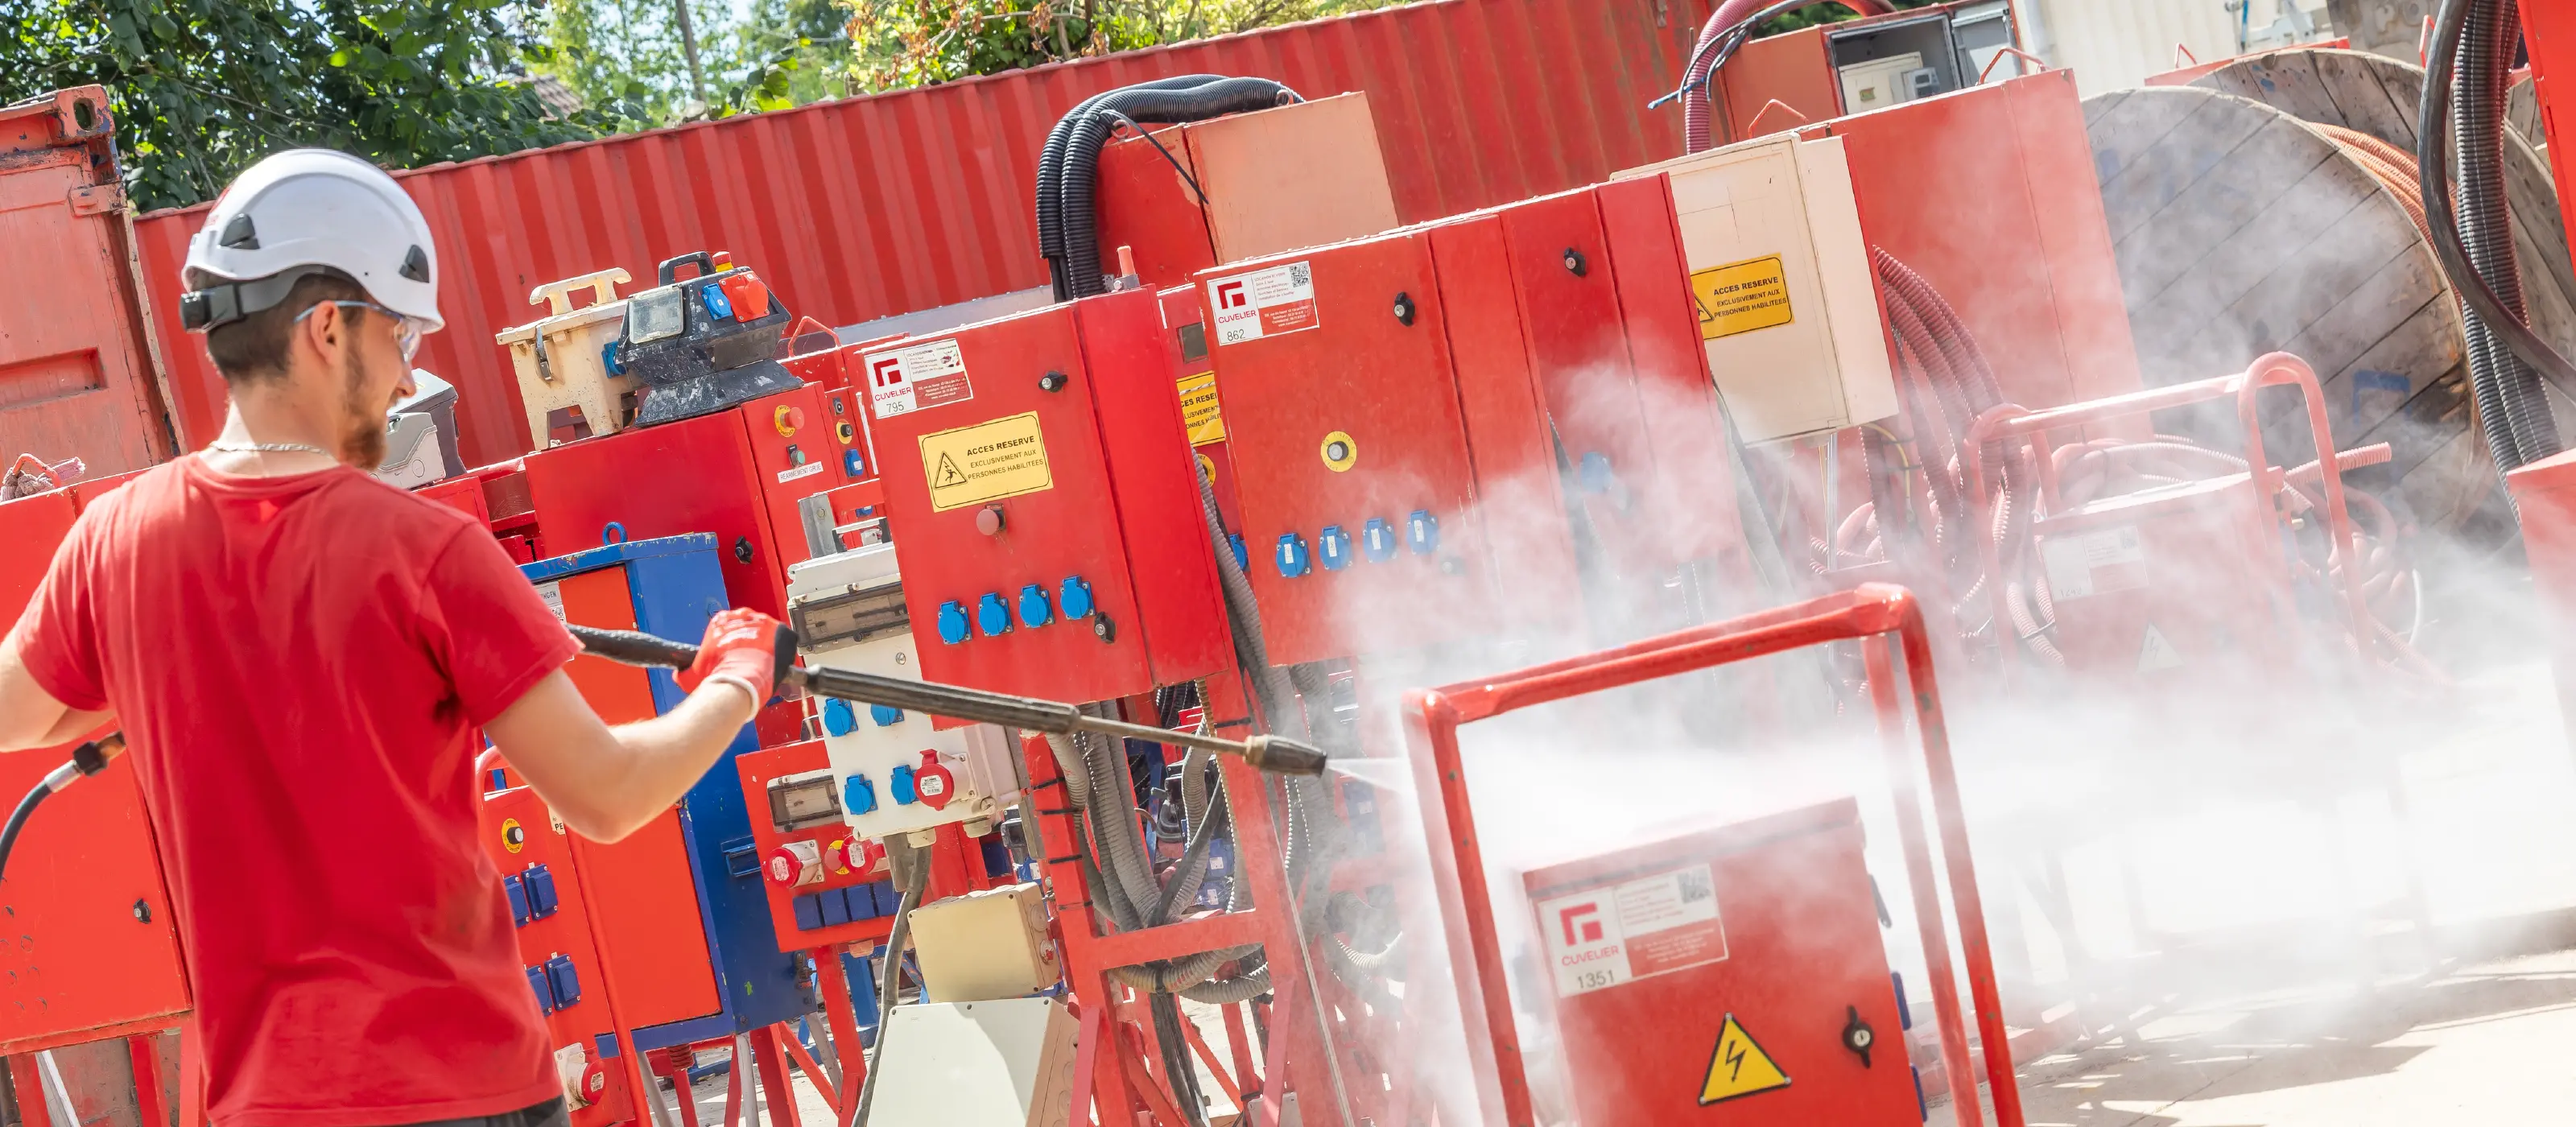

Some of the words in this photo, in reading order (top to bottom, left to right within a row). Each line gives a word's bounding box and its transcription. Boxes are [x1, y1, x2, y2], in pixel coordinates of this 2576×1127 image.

[1714, 284, 1740, 295] ACCES
[1742, 276, 1778, 290] RESERVE
[1714, 306, 1750, 317] PERSONNES
[1752, 298, 1786, 311] HABILITEES
[1716, 292, 1766, 308] EXCLUSIVEMENT
[1768, 289, 1780, 297] AUX
[1218, 310, 1257, 324] CUVELIER
[1227, 328, 1245, 341] 862
[874, 386, 911, 402] CUVELIER
[886, 401, 904, 413] 795
[967, 444, 994, 456] ACCES
[997, 436, 1034, 450] RESERVE
[970, 452, 1022, 469] EXCLUSIVEMENT
[1024, 448, 1037, 457] AUX
[780, 467, 808, 480] REARMEMENT
[808, 464, 822, 473] GRUE
[968, 466, 1006, 481] PERSONNES
[1007, 458, 1044, 472] HABILITEES
[1562, 945, 1619, 967] CUVELIER
[1577, 969, 1615, 989] 1351
